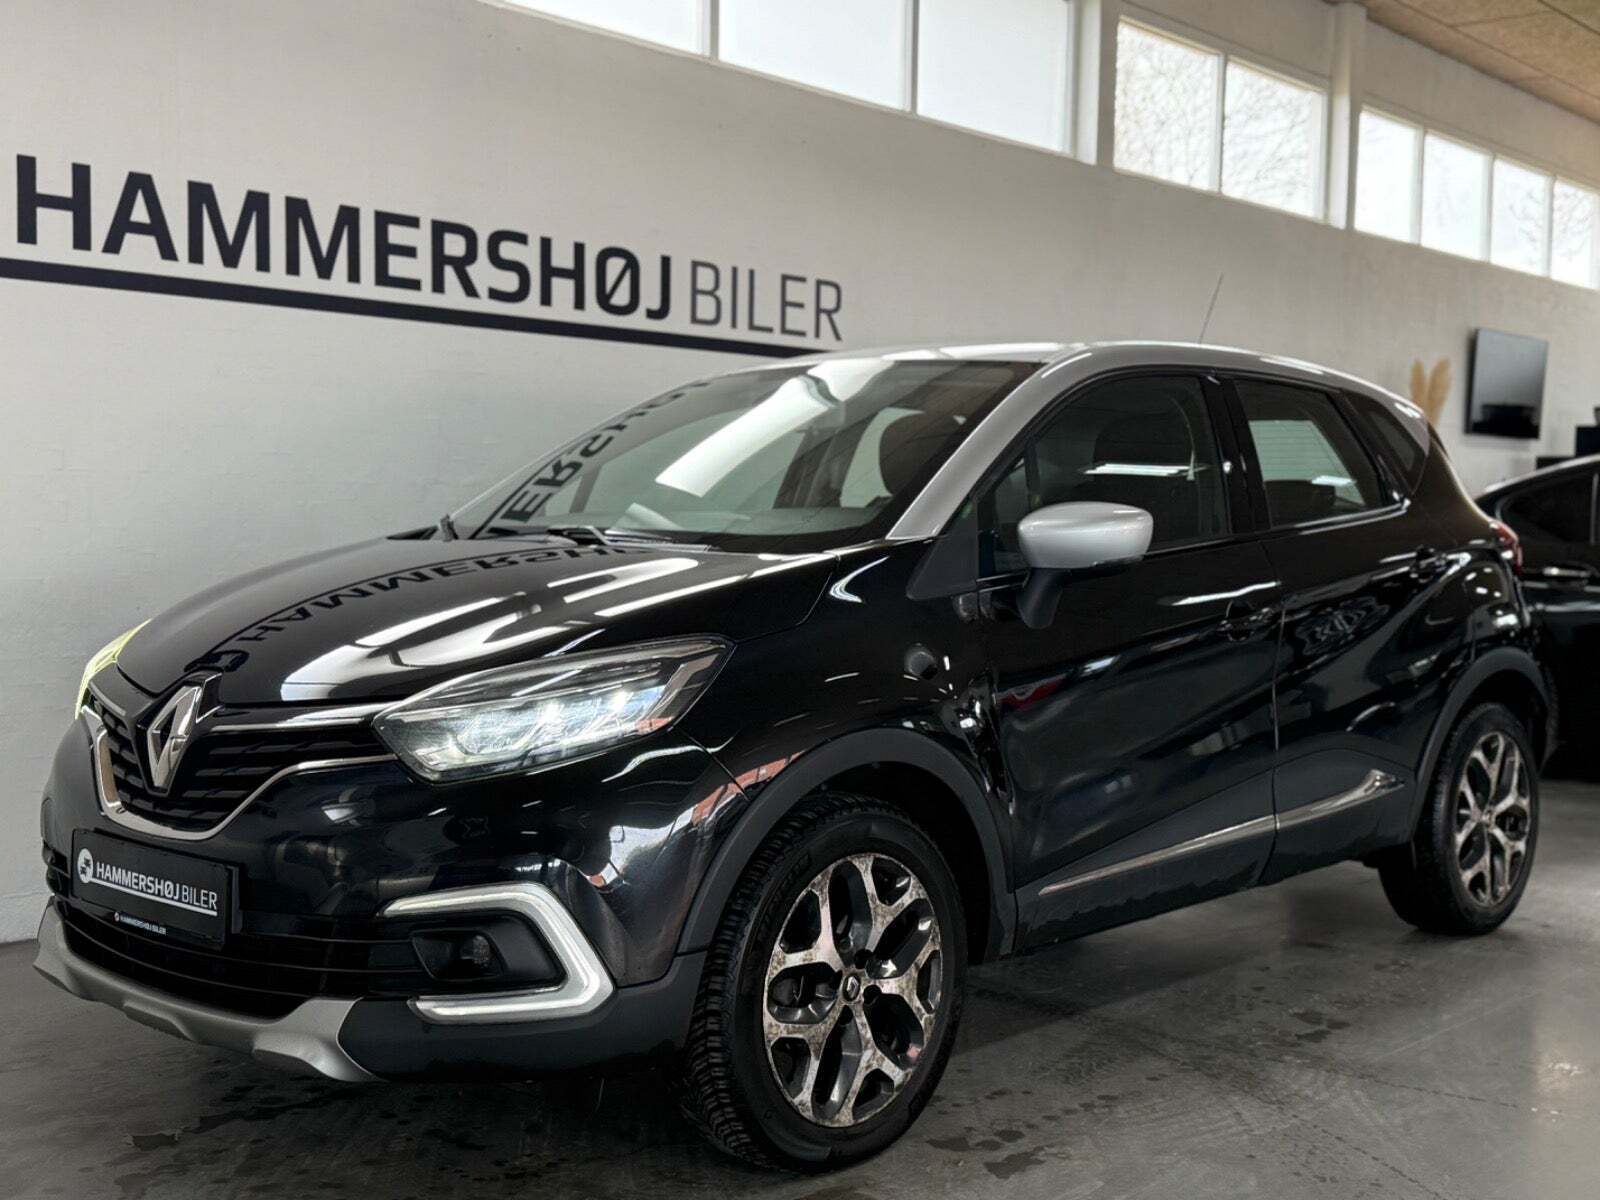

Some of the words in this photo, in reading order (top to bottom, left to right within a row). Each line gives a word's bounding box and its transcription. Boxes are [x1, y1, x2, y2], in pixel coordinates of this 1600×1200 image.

[15, 153, 673, 322] HAMMERSHØJ
[689, 259, 844, 343] BILER
[95, 861, 180, 900] HAMMERSHØJ
[181, 885, 218, 910] BILER
